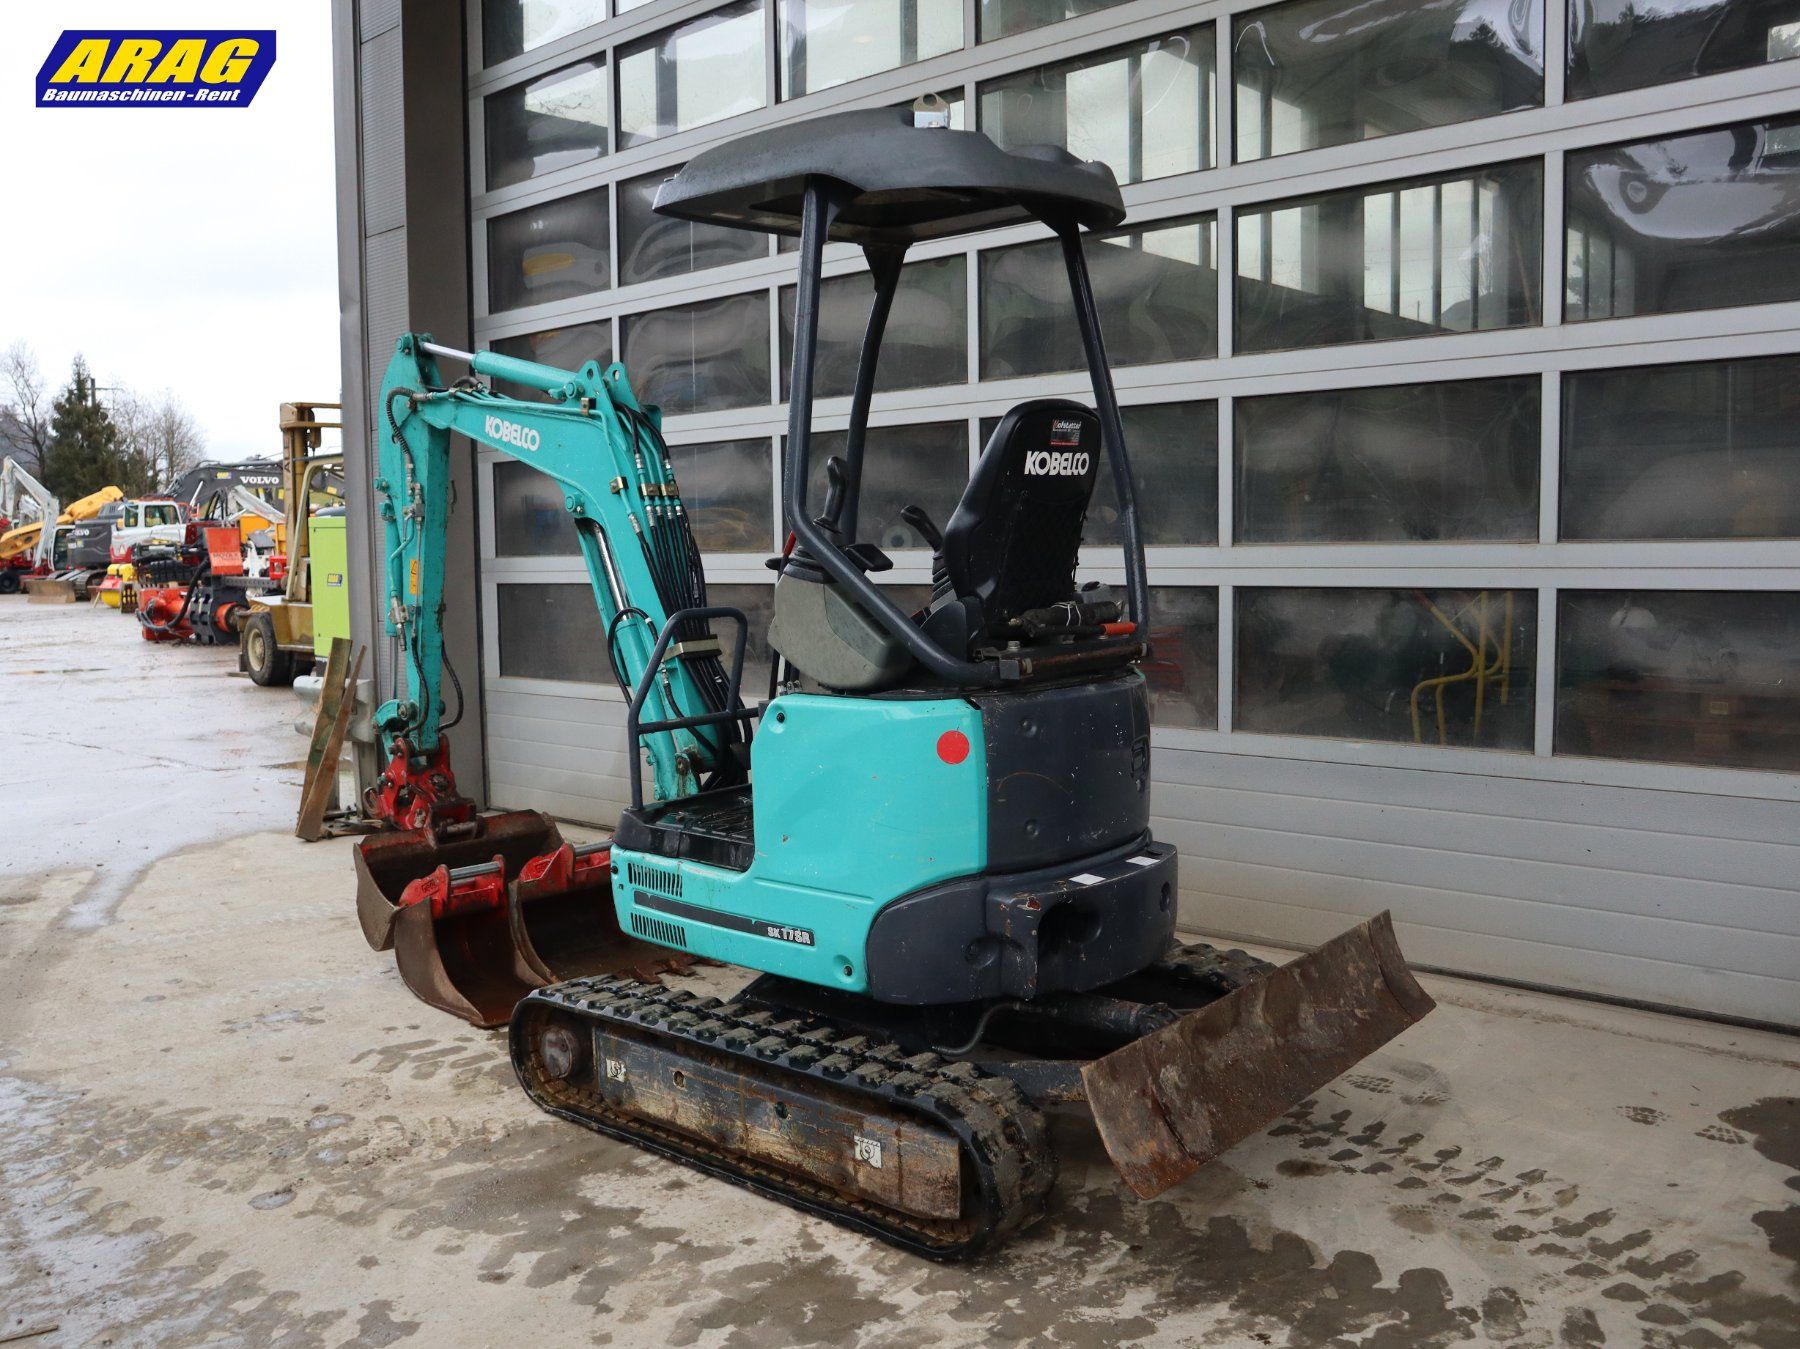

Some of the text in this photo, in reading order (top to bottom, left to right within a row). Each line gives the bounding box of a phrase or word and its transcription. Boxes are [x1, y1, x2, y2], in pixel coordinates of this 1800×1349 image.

[485, 415, 540, 451] KOBELCO
[1024, 451, 1090, 476] KOBELCO
[240, 476, 280, 484] VOLVO
